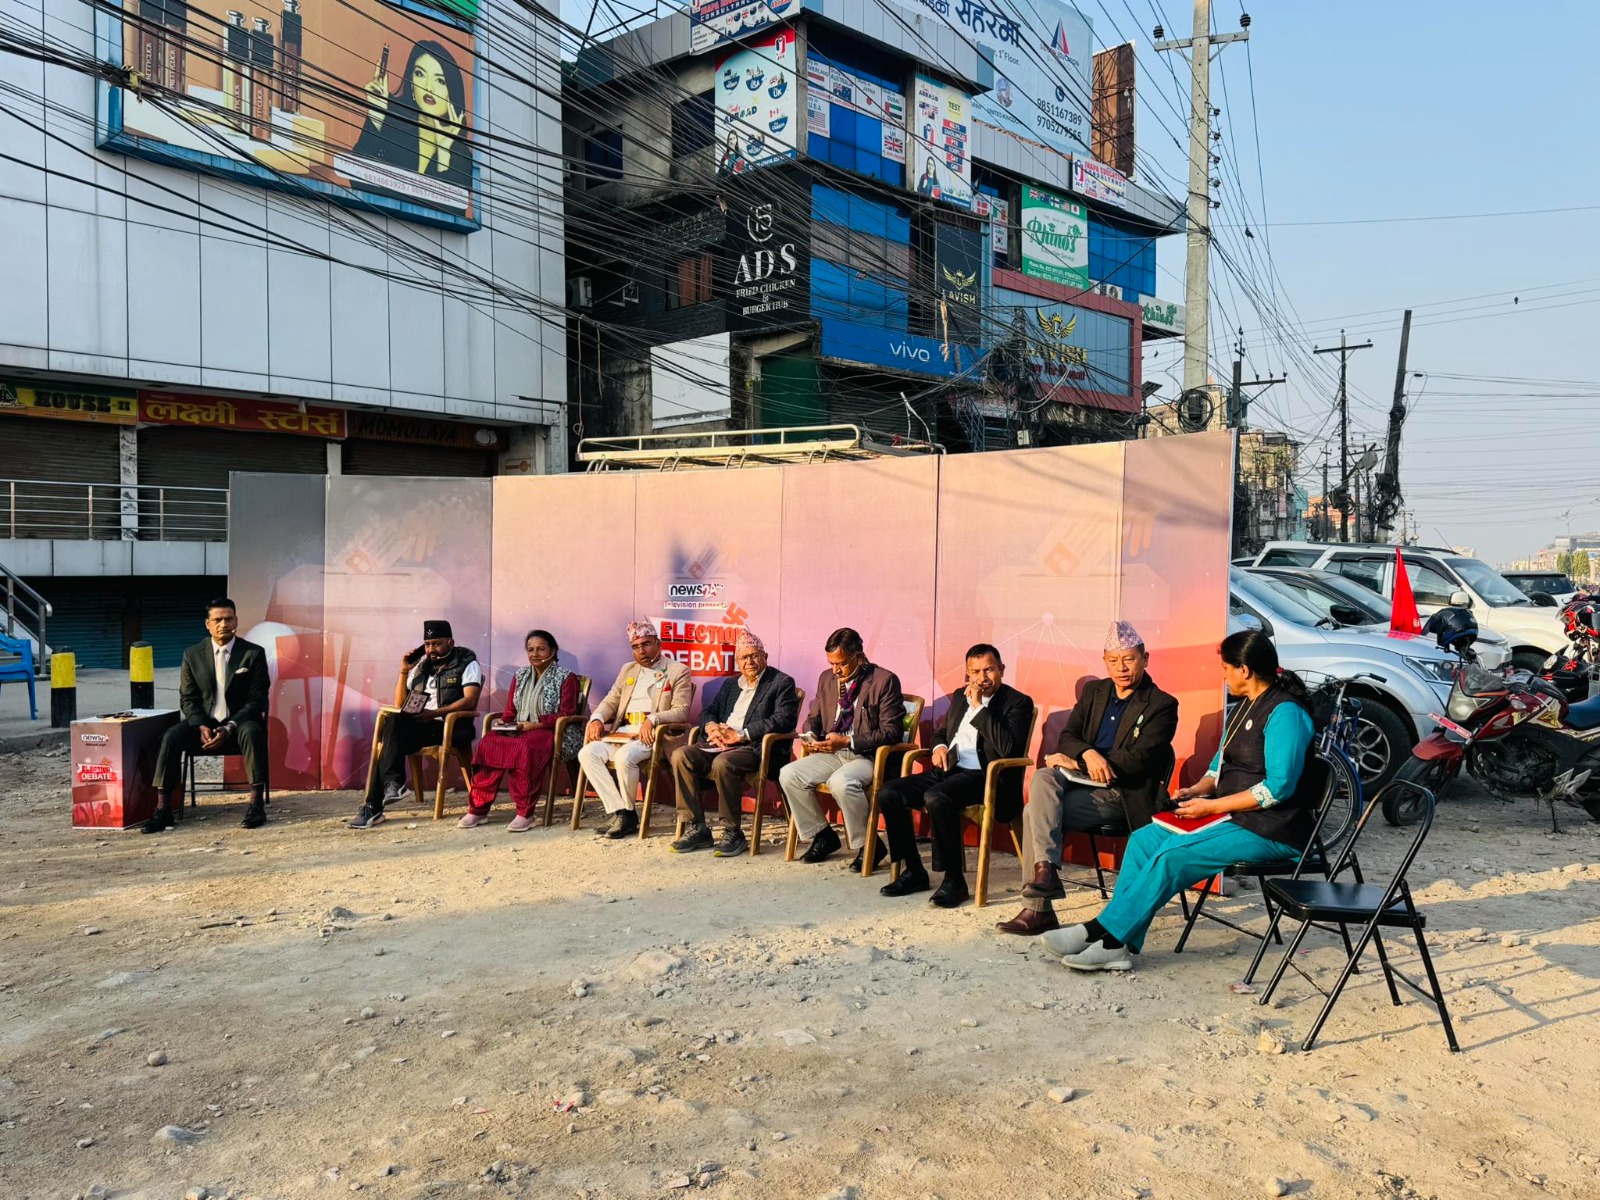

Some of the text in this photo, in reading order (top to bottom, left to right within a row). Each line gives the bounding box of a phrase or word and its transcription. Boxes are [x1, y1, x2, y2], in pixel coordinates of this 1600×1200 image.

[948, 101, 961, 112] TEST
[1037, 98, 1082, 126] 9851167389
[734, 243, 796, 285] ADS
[736, 279, 796, 298] FRIED CHICKEN
[742, 300, 789, 316] BURGER HUB
[889, 341, 930, 362] vivo
[145, 400, 340, 435] लक्ष्मी स्टोर्स
